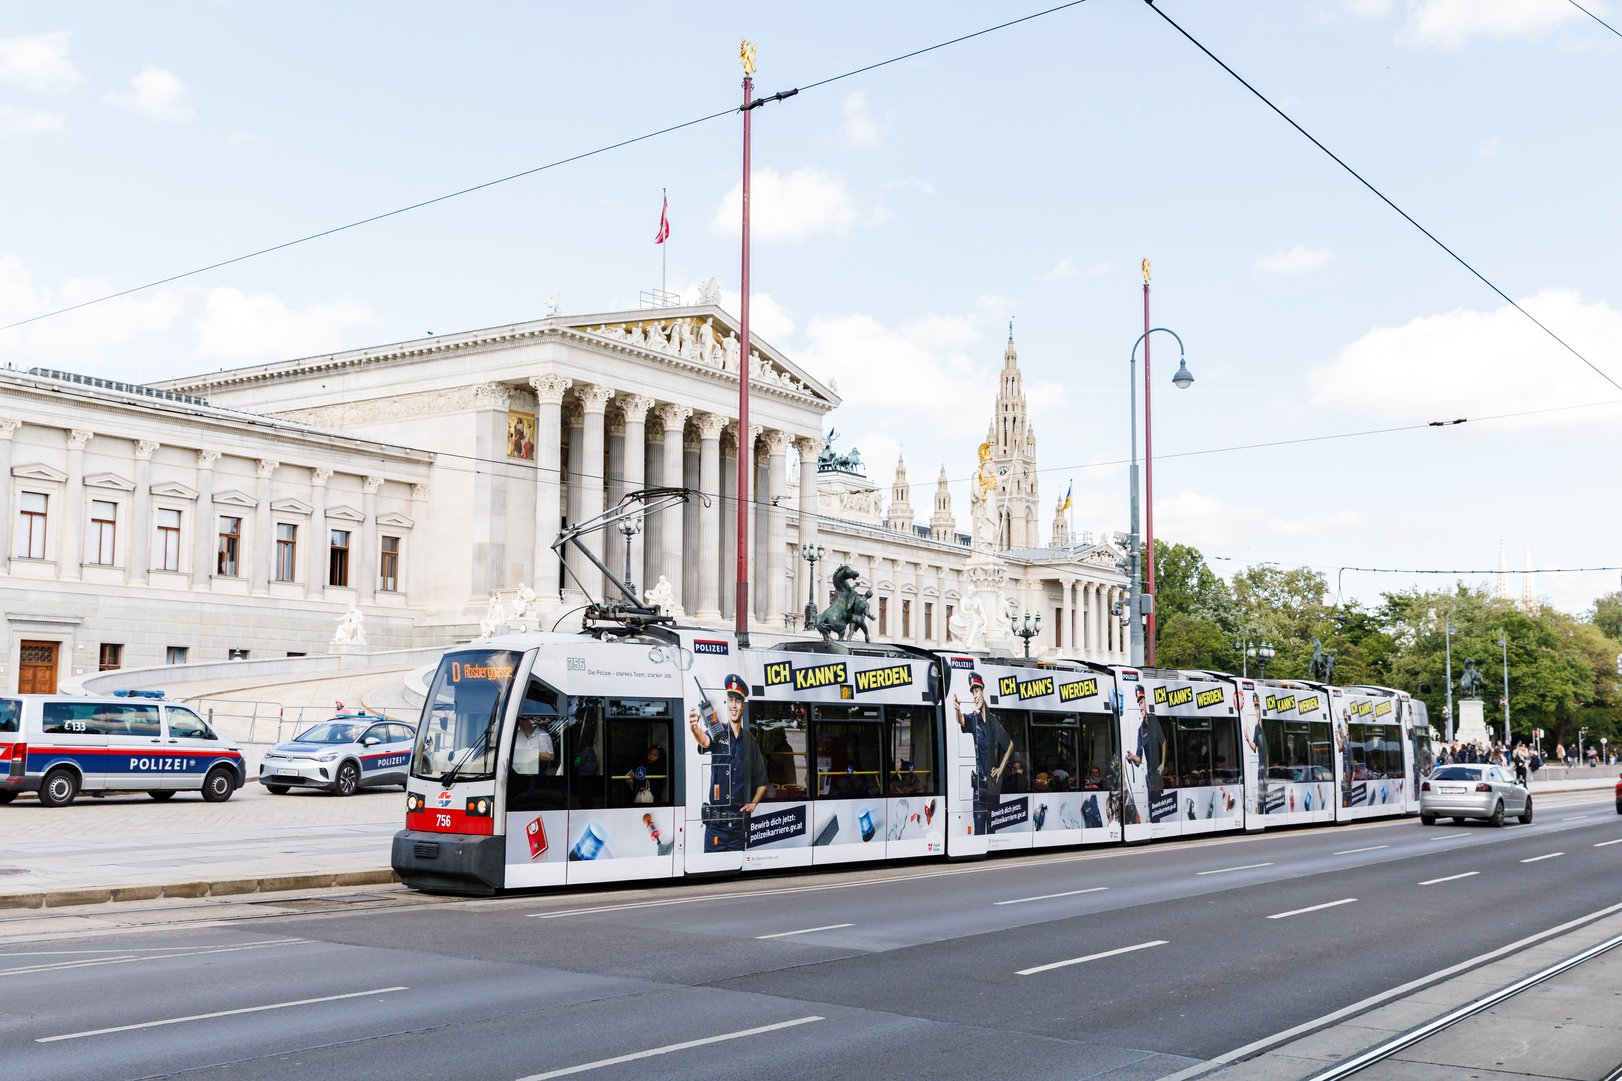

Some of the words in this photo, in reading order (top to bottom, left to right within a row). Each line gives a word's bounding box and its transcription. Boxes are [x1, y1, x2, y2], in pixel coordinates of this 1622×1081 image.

[695, 644, 723, 652] POLIZEI
[567, 657, 585, 670] 756
[951, 660, 972, 668] POLIZEI
[452, 661, 461, 682] D
[464, 663, 513, 680] Absberggasse
[767, 663, 791, 685] ICH
[795, 665, 846, 688] KANN'S
[856, 666, 912, 690] WERDEN.
[1000, 678, 1016, 696] ICH
[1020, 678, 1053, 699] KANN'S
[1060, 680, 1098, 700] WERDEN.
[1155, 688, 1167, 703] ICH
[1168, 687, 1192, 706] KANN'S
[1196, 688, 1224, 707] WERDEN.
[71, 722, 86, 731] 133
[130, 758, 187, 770] POLIZEI
[377, 756, 402, 767] POLIZEI
[436, 814, 451, 827] 756
[750, 820, 770, 831] Bewirb
[770, 816, 782, 826] dich
[782, 813, 796, 825] jetzt:
[750, 822, 803, 843] polizeikarriere.gv.at
